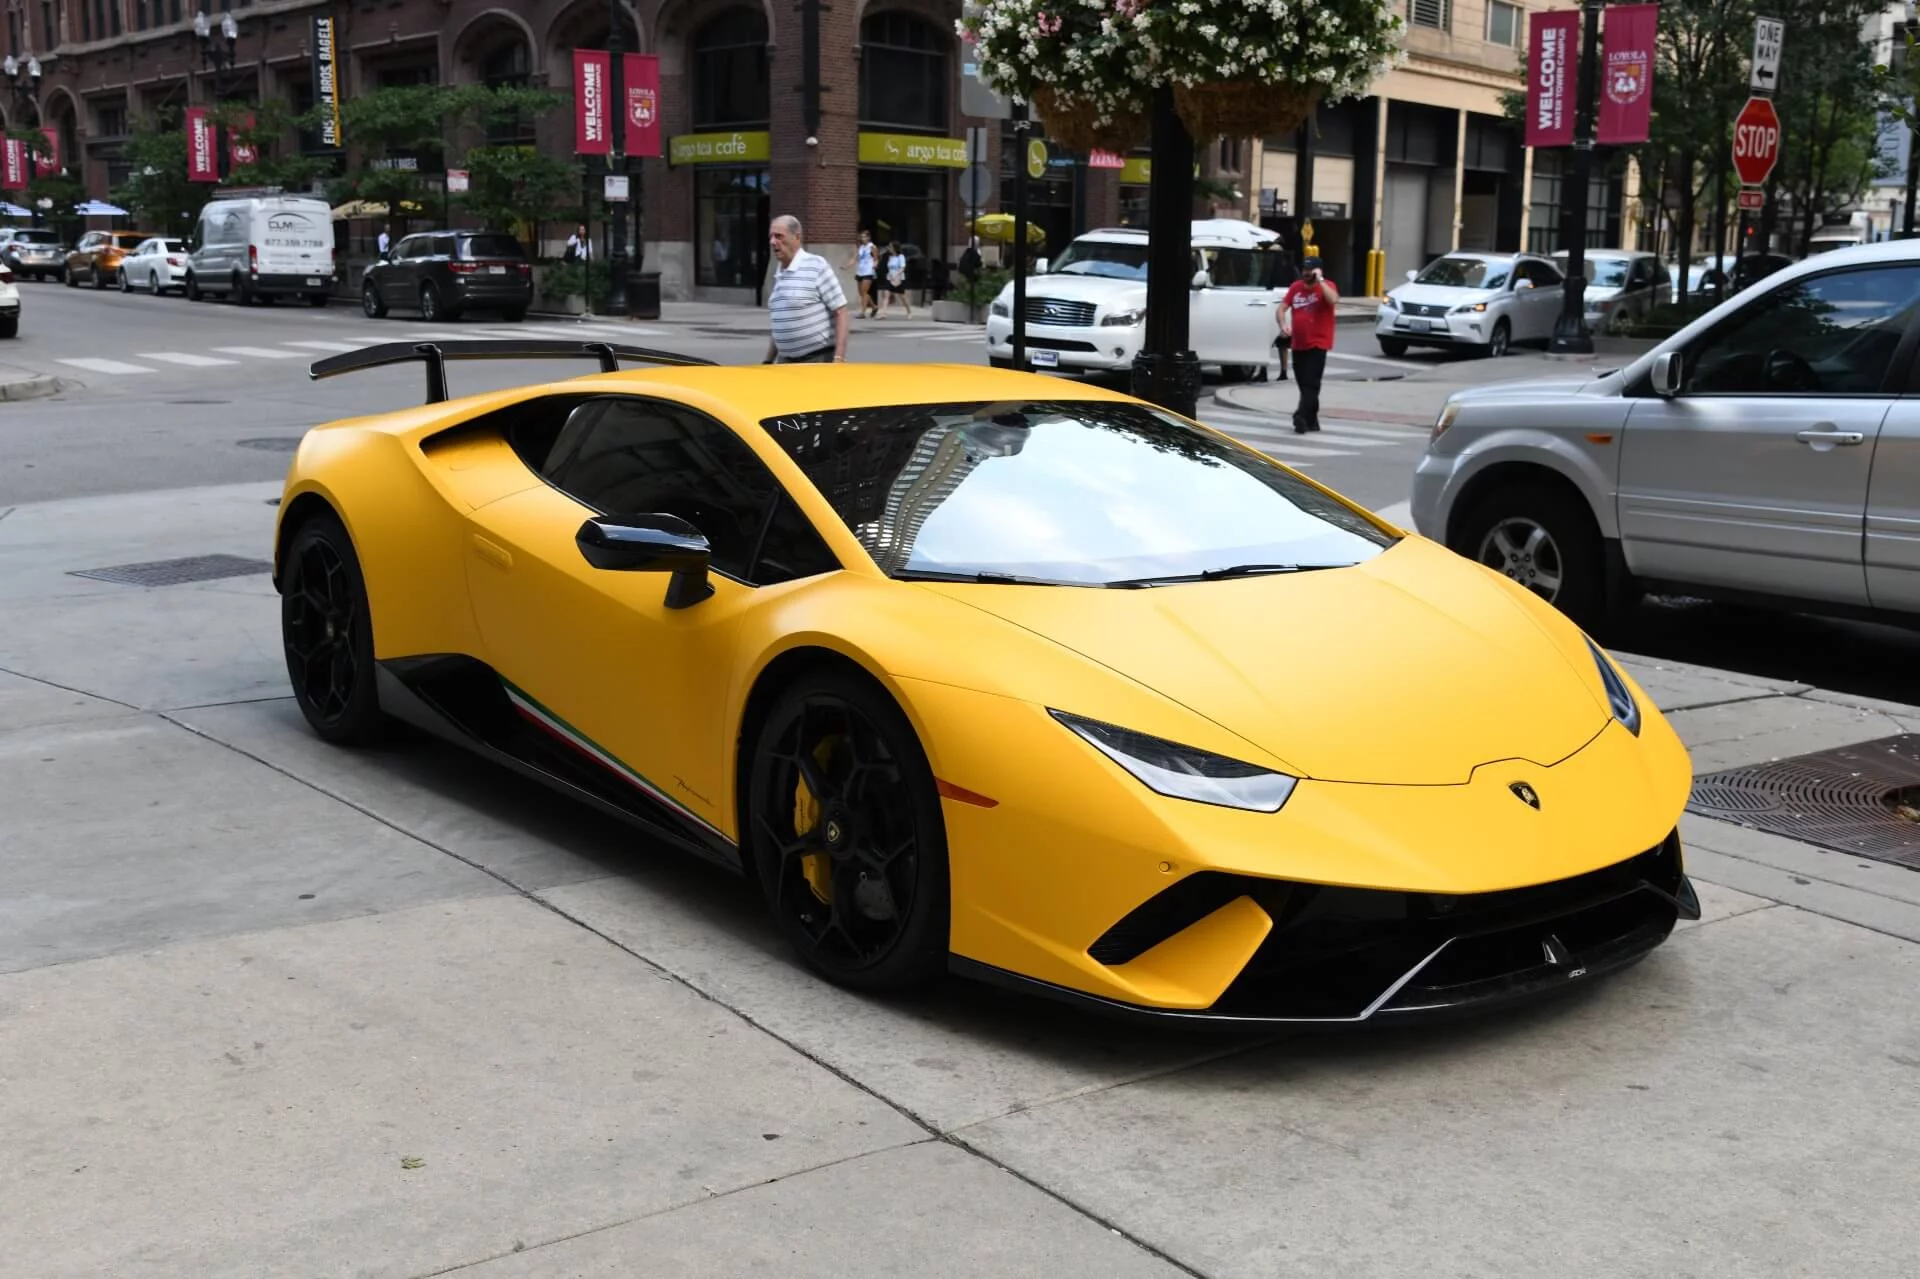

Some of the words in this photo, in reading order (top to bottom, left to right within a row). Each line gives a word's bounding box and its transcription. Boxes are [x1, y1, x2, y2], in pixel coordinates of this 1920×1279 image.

[318, 18, 331, 60] BAGELS
[1557, 28, 1566, 66] CAMPUS
[1760, 24, 1781, 43] ONE
[1608, 50, 1647, 61] LOYOLA
[1757, 44, 1779, 60] WAY
[1538, 28, 1556, 129] WELCOME
[1555, 67, 1564, 98] TOWER
[584, 63, 596, 141] WELCOME
[1554, 100, 1562, 129] WATER
[321, 97, 336, 144] EINSN
[194, 118, 206, 172] WELCOME
[716, 133, 746, 154] café
[907, 145, 935, 164] argo
[936, 144, 951, 160] tea
[1736, 124, 1777, 158] STOP
[7, 139, 17, 182] WELCOME
